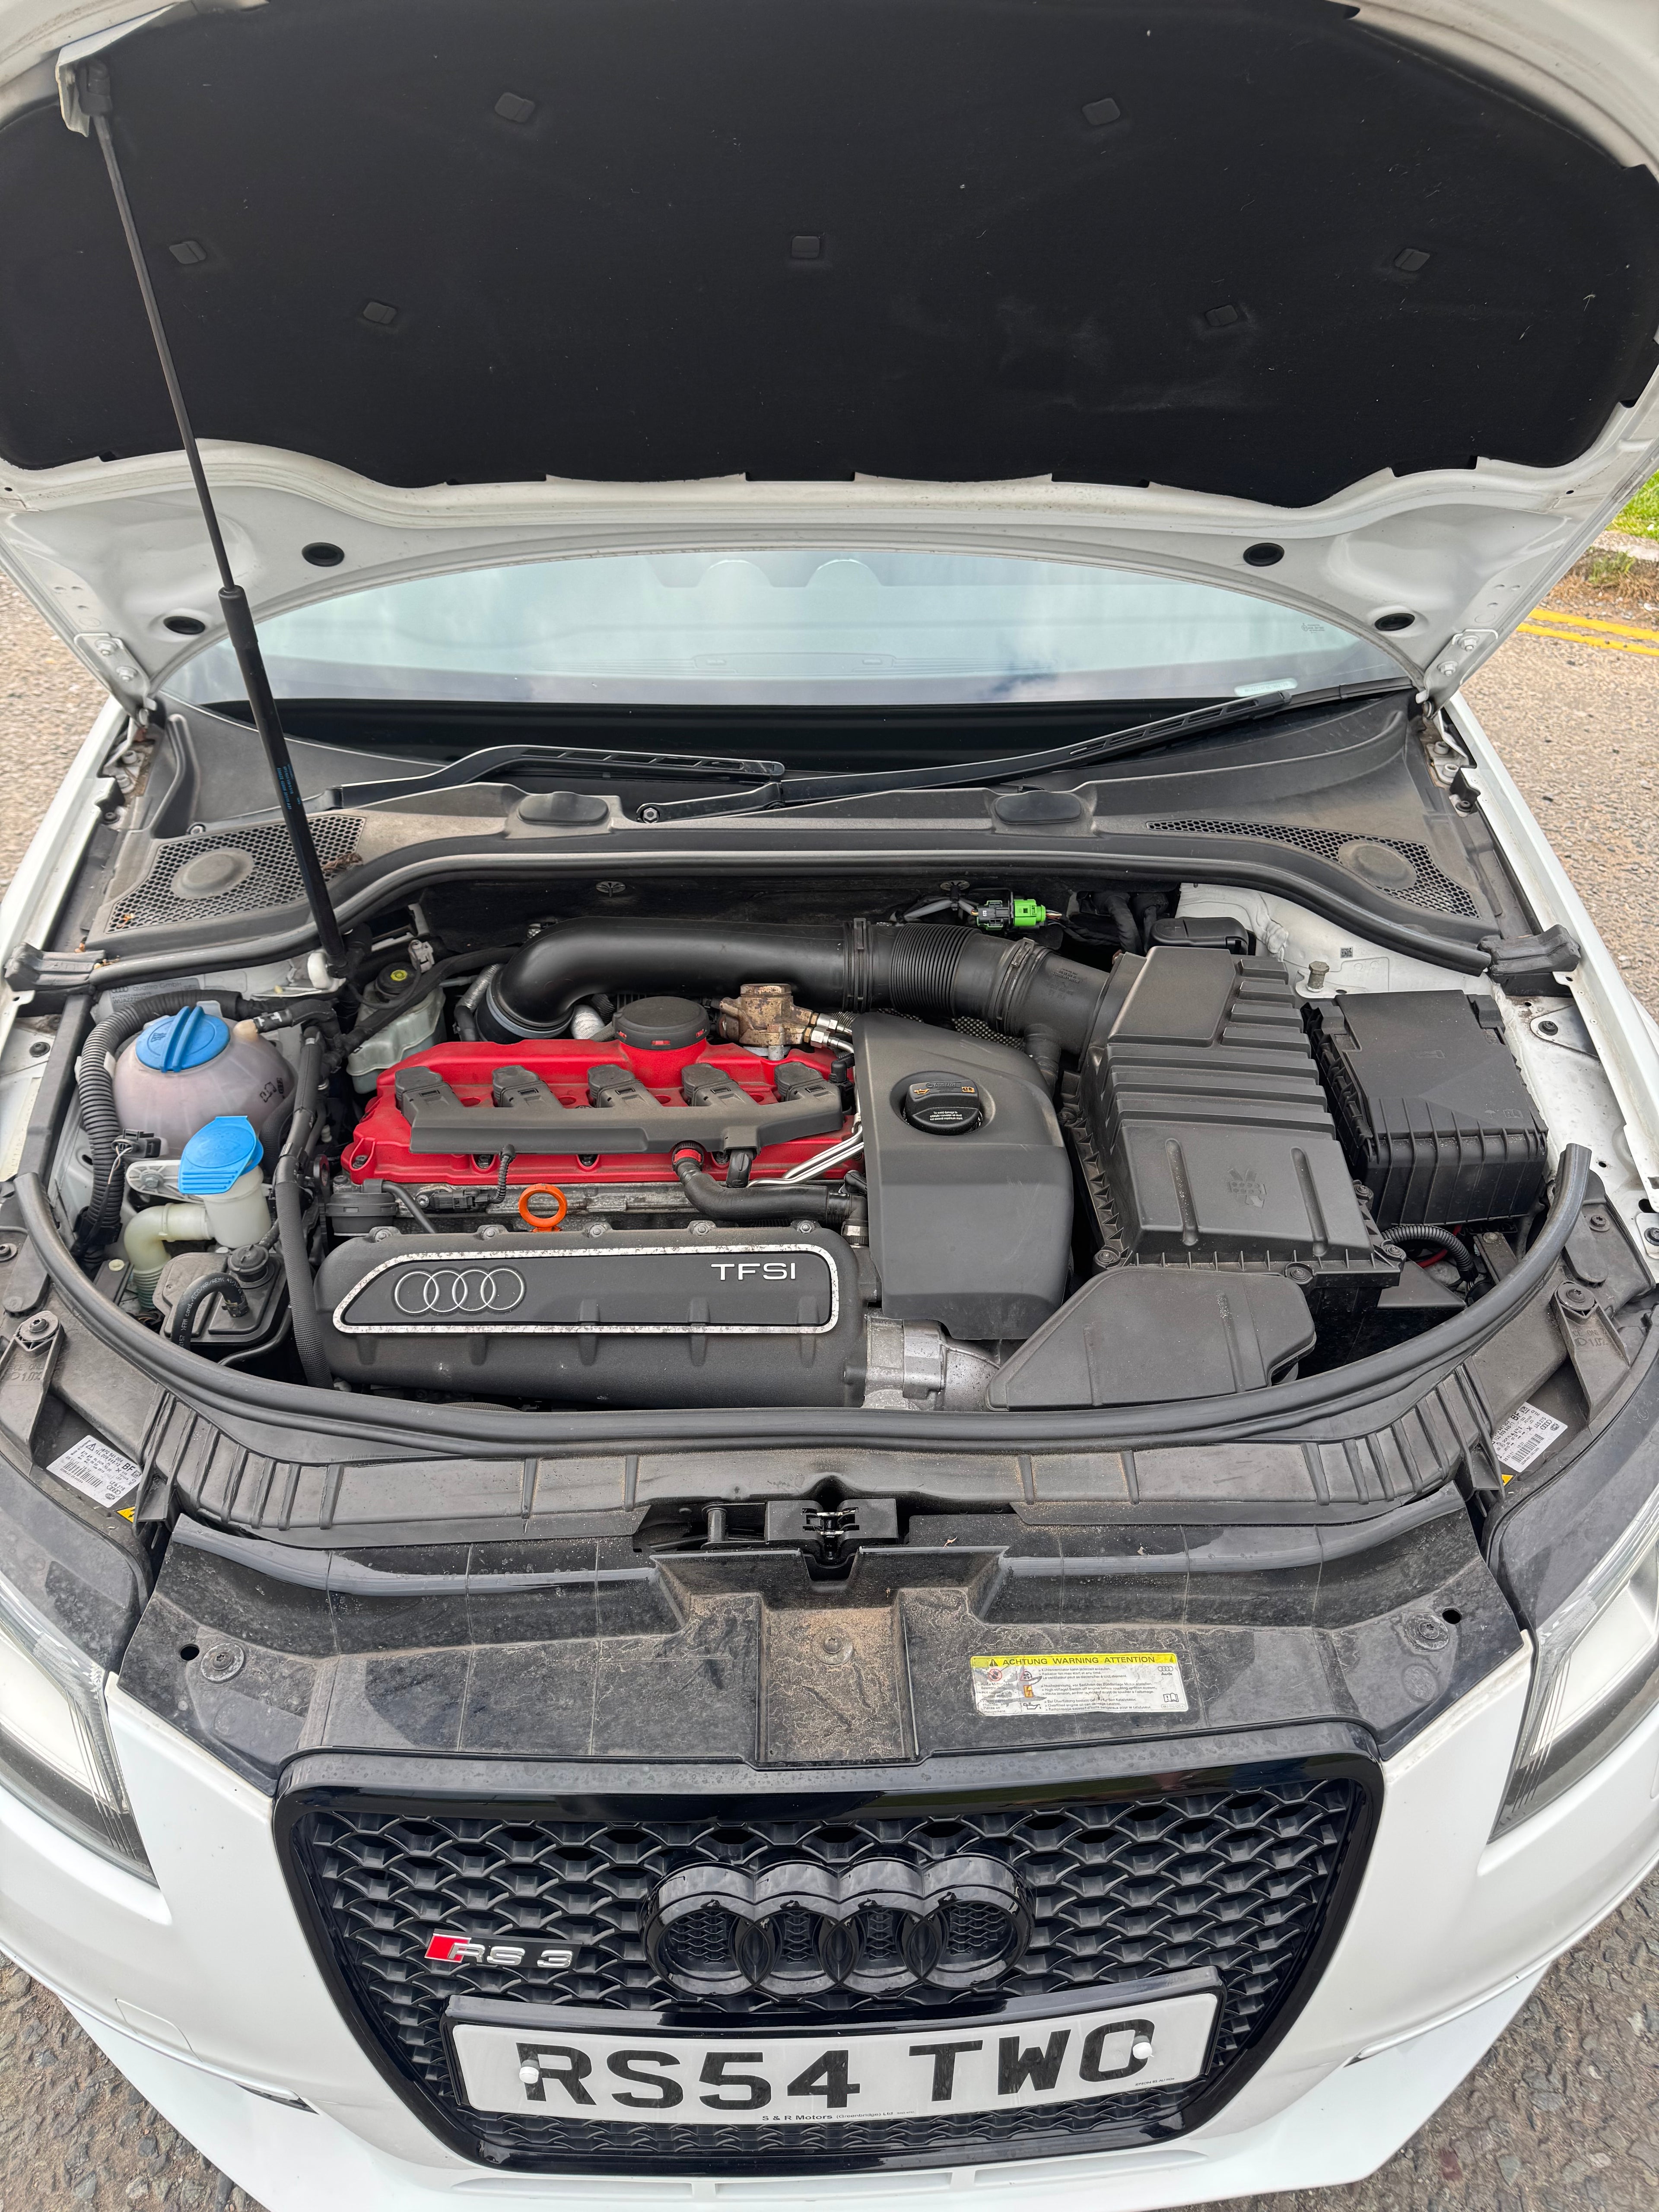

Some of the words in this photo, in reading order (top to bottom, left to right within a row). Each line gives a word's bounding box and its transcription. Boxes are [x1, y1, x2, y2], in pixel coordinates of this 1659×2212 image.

[710, 1262, 796, 1282] TFSI
[1511, 1411, 1521, 1421] BF
[121, 1463, 136, 1471] BF
[448, 1942, 525, 1965] RS
[537, 1949, 573, 1968] 3
[516, 2041, 860, 2111] RS54
[909, 2018, 1156, 2102] TWO
